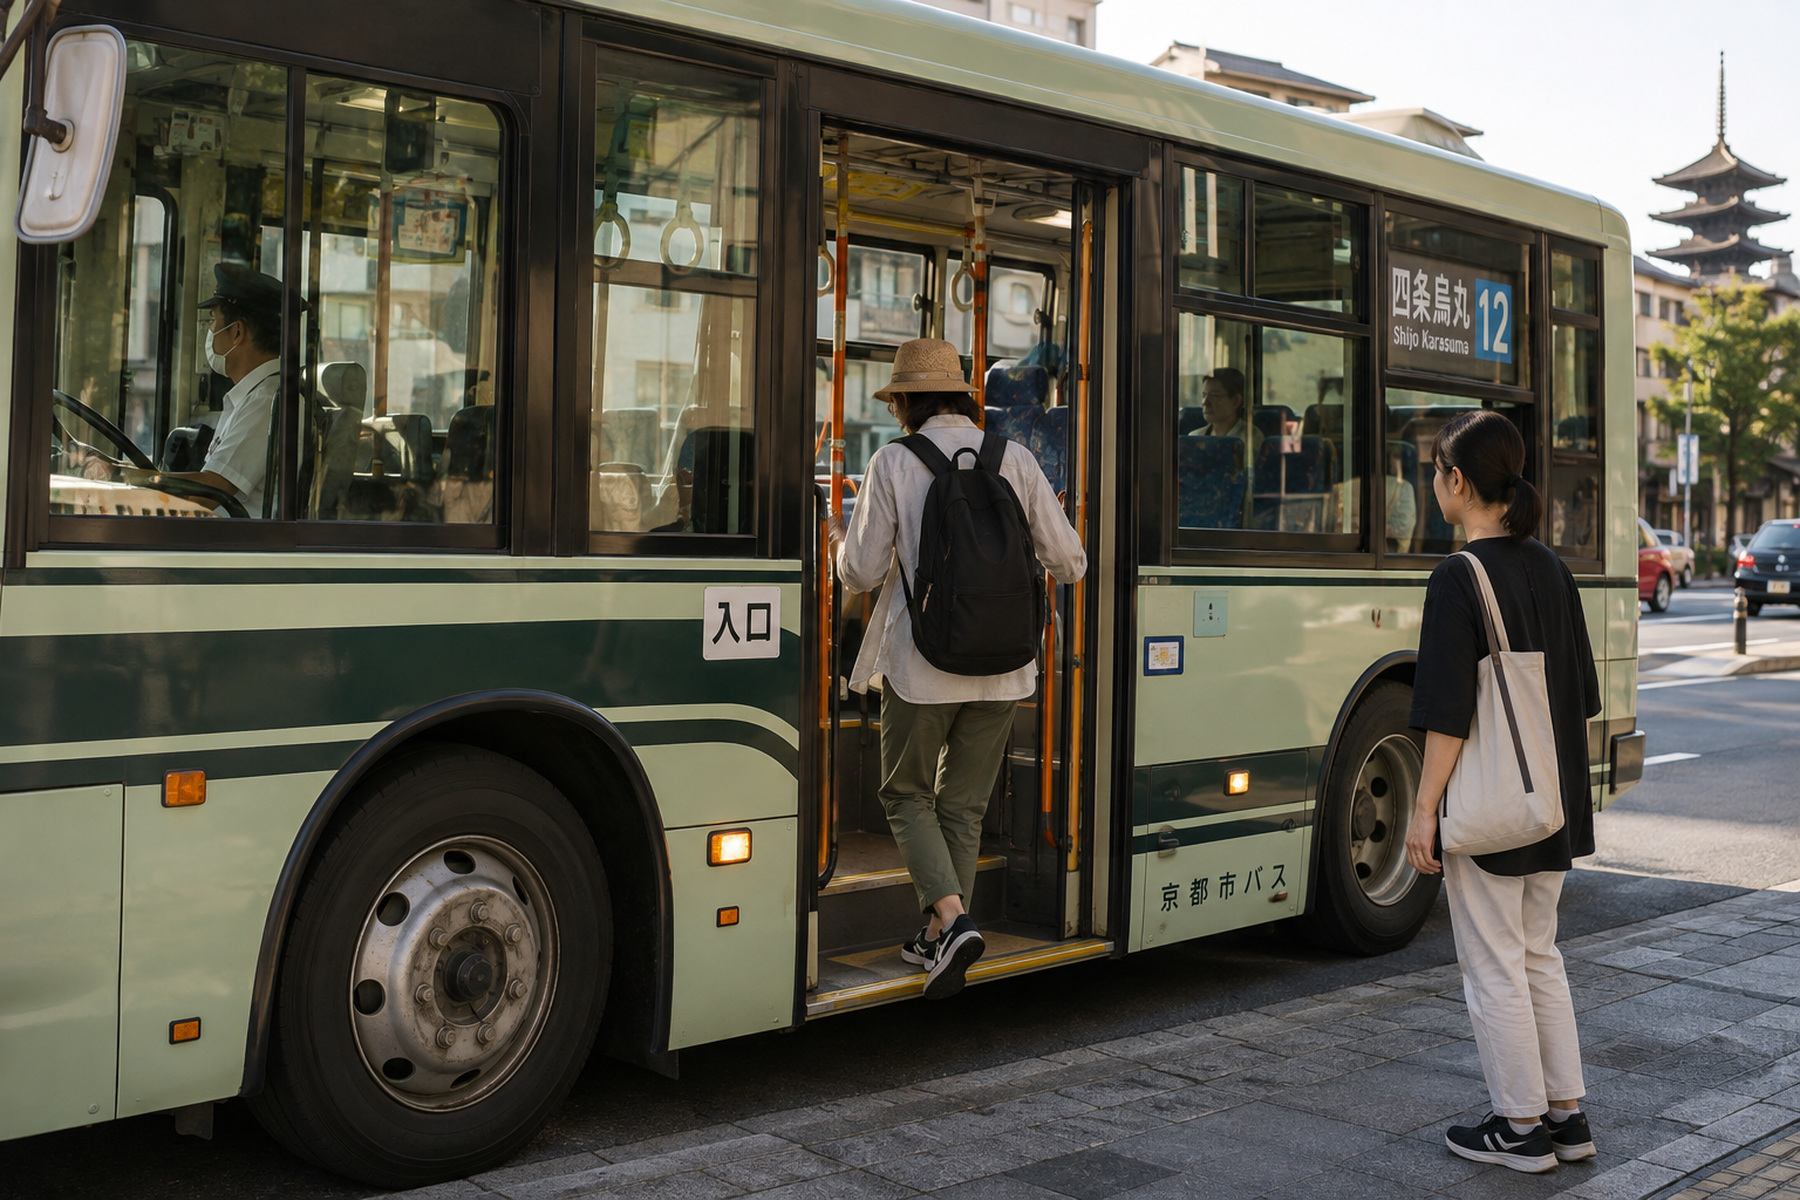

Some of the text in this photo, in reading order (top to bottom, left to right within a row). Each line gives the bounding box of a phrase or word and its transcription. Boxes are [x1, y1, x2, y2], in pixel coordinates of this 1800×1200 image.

[1392, 266, 1470, 330] 四条烏丸
[1479, 288, 1508, 354] 12
[1393, 325, 1419, 351] Shijo
[712, 602, 771, 645] 入口
[1160, 863, 1287, 912] 京都市バス
